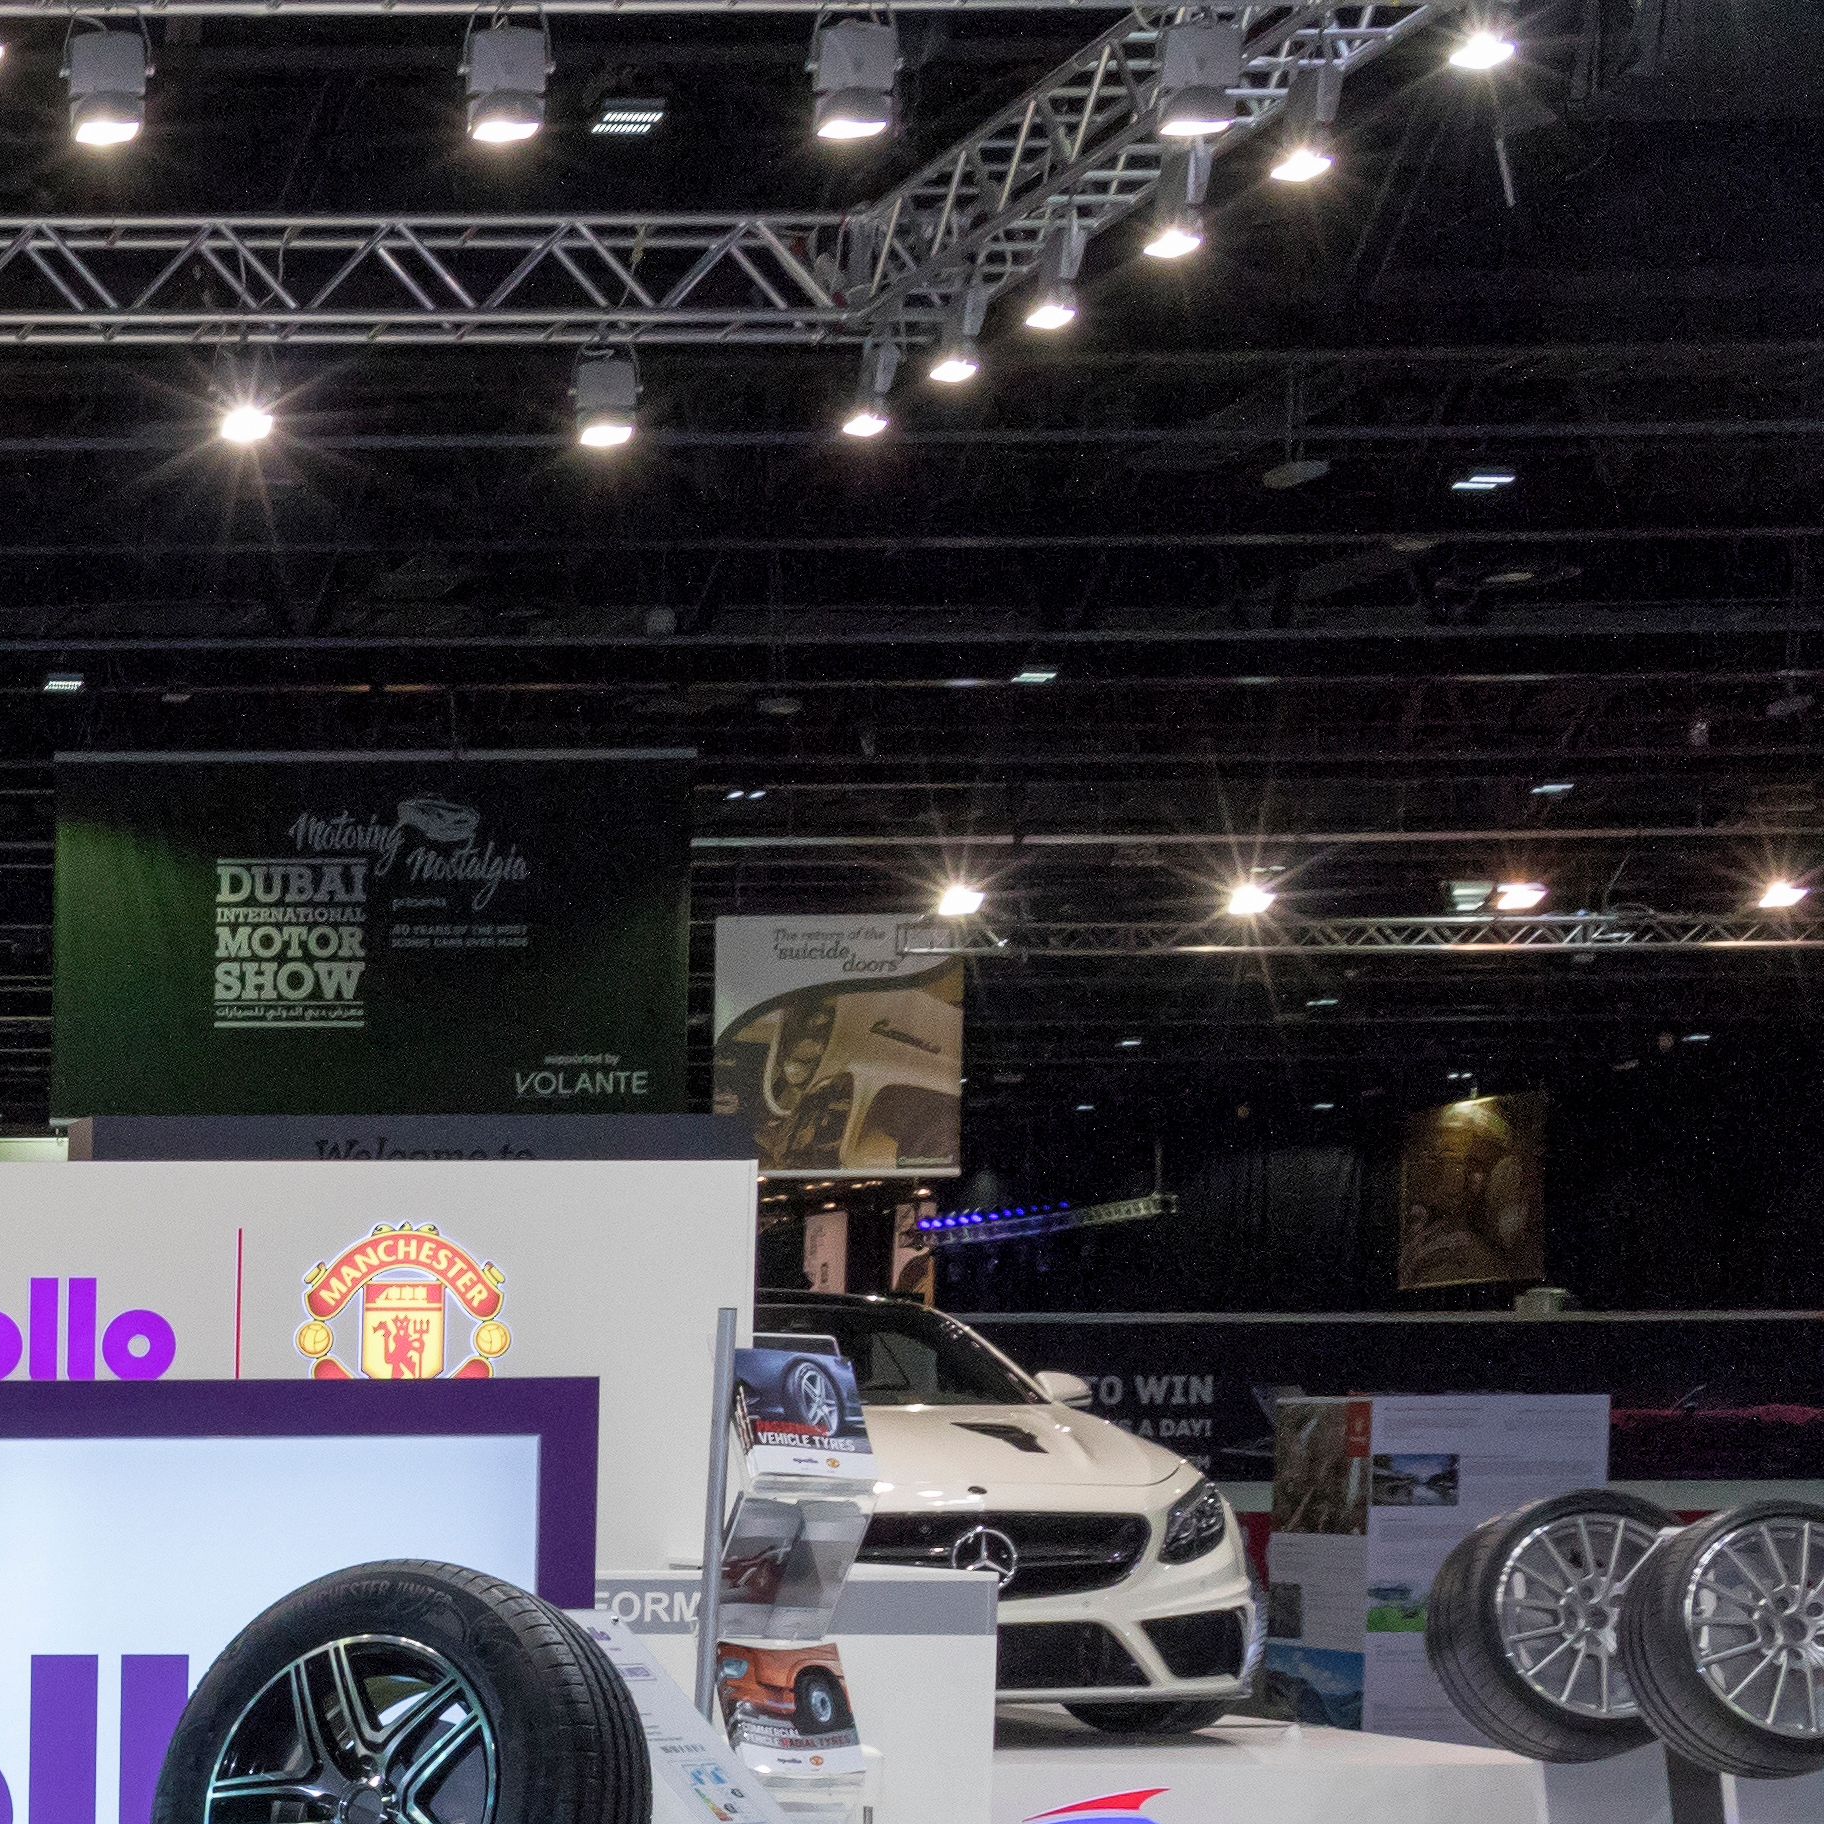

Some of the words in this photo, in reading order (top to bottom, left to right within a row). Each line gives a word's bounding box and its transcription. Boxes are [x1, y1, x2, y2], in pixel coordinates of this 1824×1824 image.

[288, 808, 406, 877] Motoring
[214, 864, 368, 904] DUBAI
[405, 831, 532, 912] Nostalgia
[215, 906, 368, 924] INTERNATIONAL
[214, 925, 368, 959] MOTOR
[213, 960, 367, 1001] SHOW
[514, 1069, 650, 1097] VOLANTE
[318, 1238, 489, 1308] MANCHESTER
[1132, 1373, 1215, 1406] WIN
[756, 1430, 812, 1448] VEHICLE
[811, 1435, 856, 1452] TYRES
[1158, 1417, 1214, 1438] DAY!
